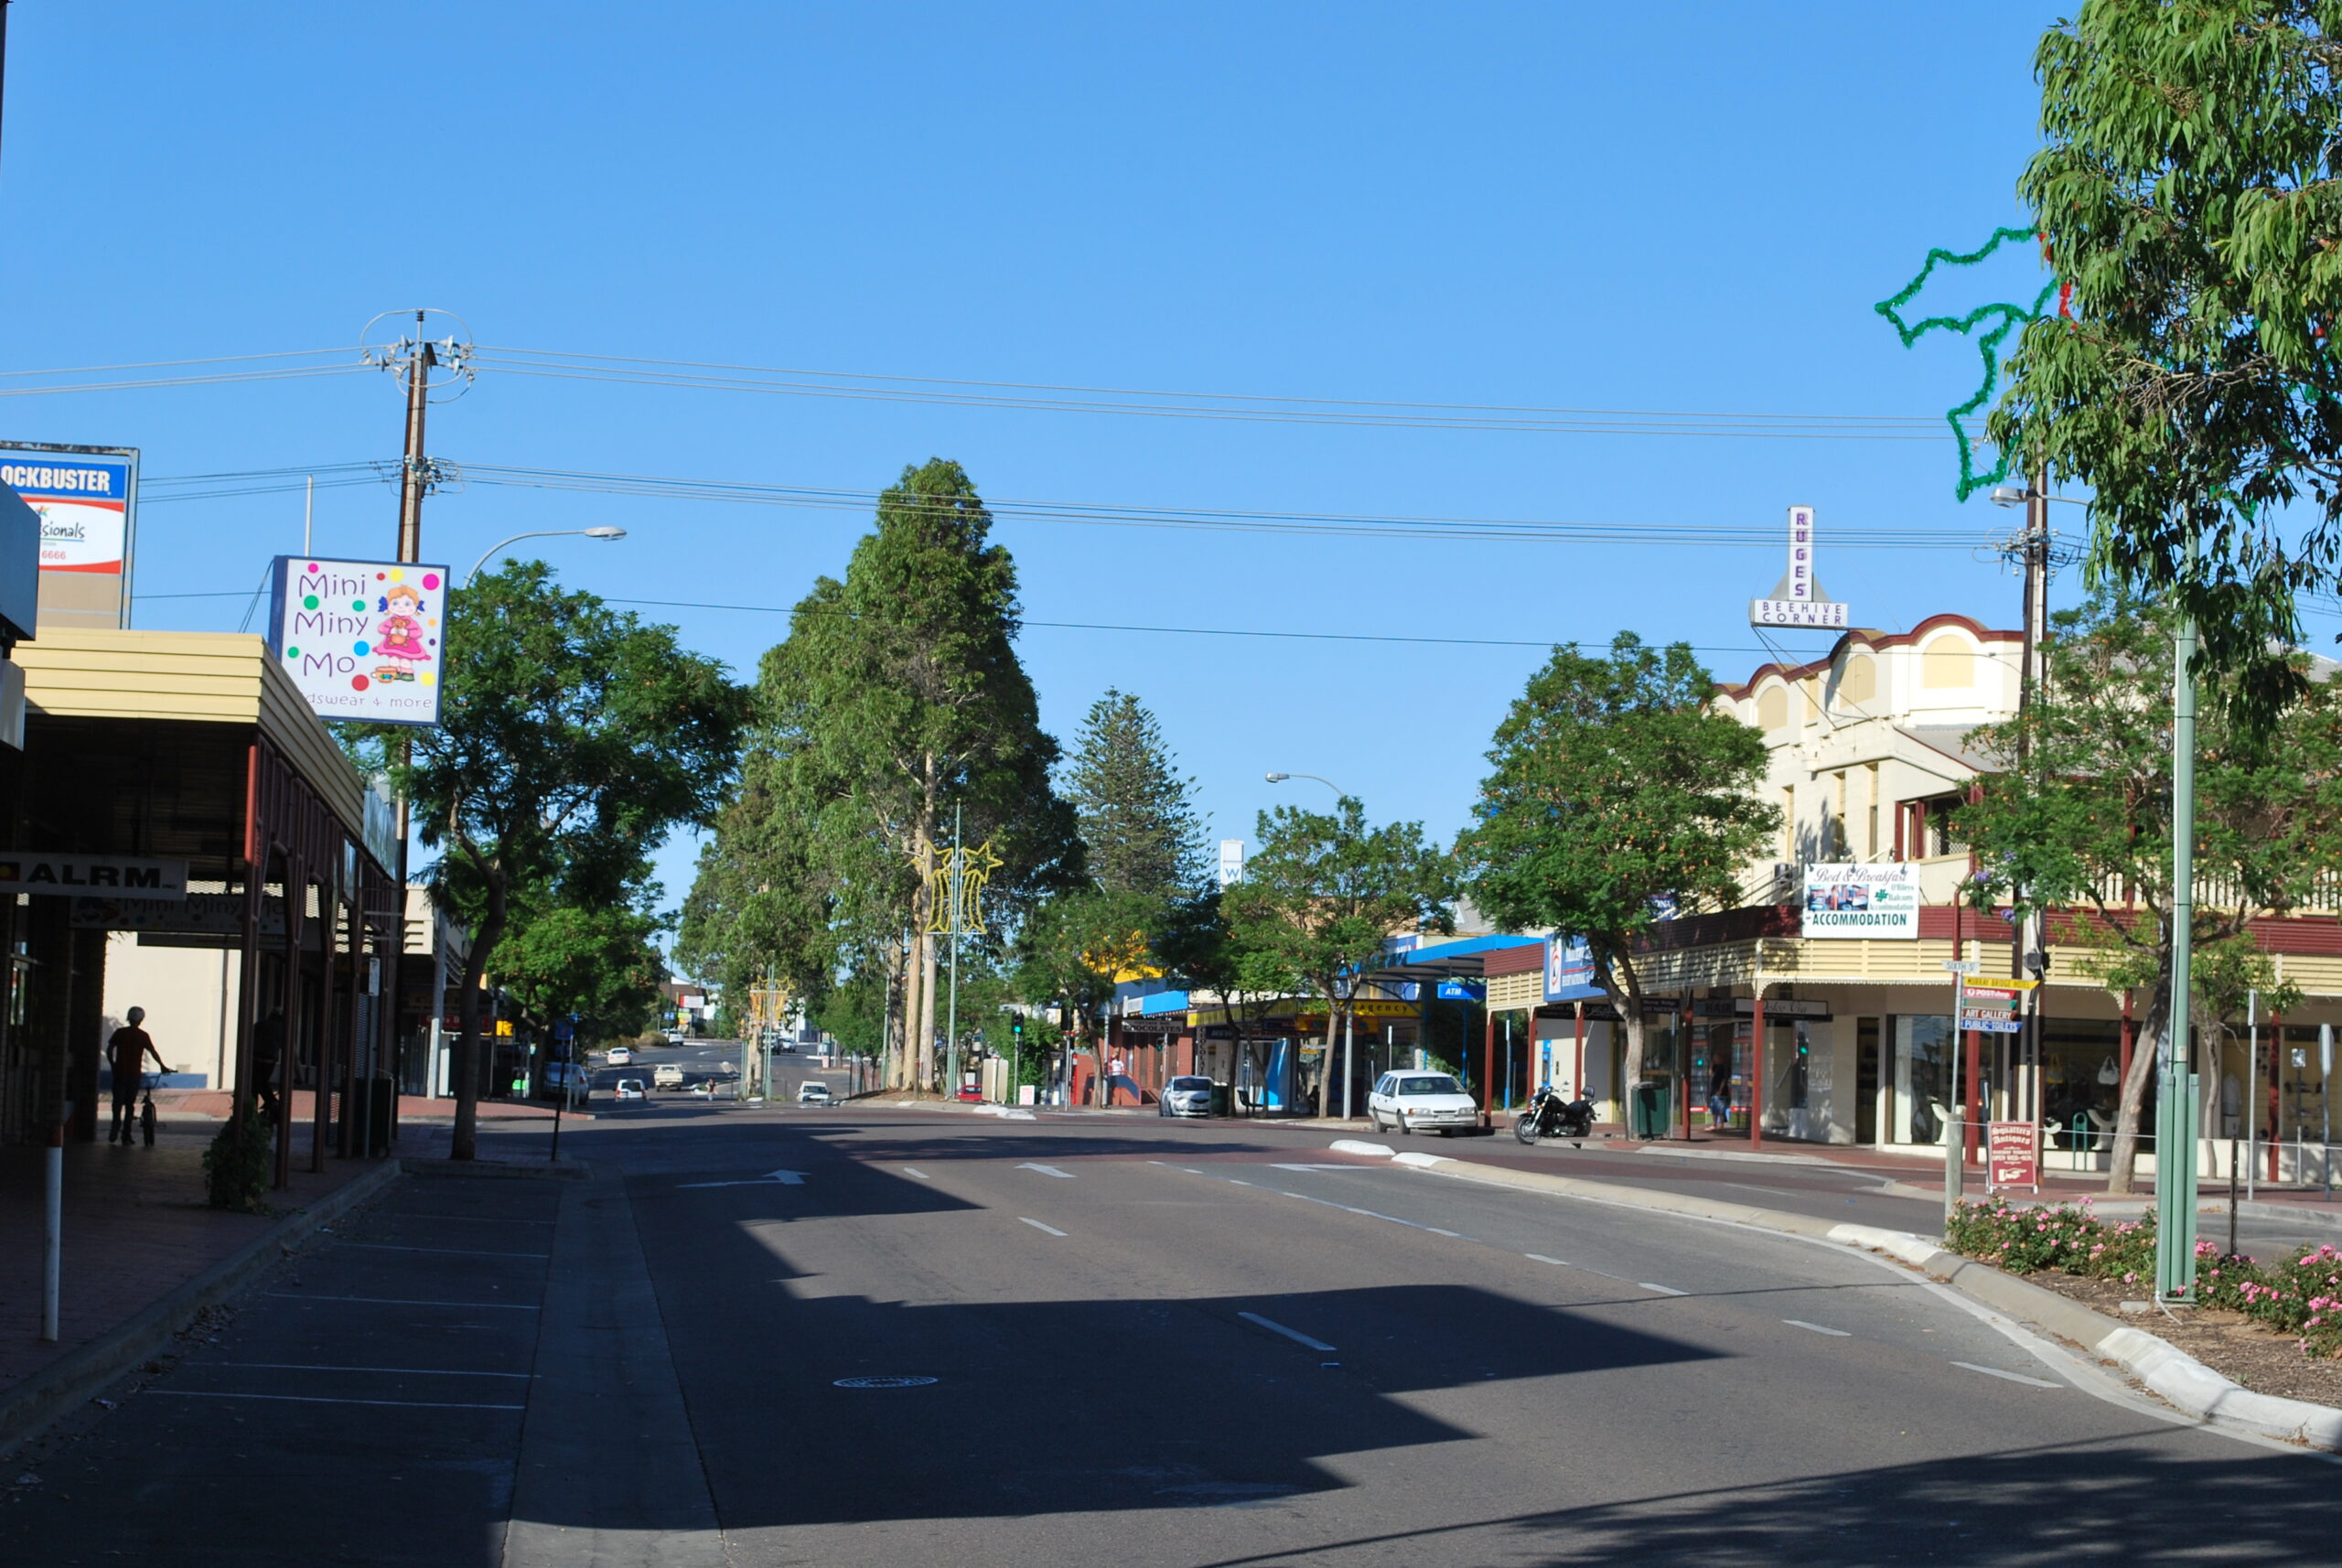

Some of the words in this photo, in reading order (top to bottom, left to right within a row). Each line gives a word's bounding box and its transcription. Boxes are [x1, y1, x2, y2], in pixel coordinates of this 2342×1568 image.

[42, 551, 66, 560] 6666
[1795, 512, 1809, 596] RUGES
[299, 574, 366, 599] Mini
[1763, 602, 1842, 615] BEEHIVE
[295, 611, 369, 637] Miny
[1762, 612, 1842, 625] CORNER
[304, 652, 355, 678] Mo
[390, 697, 432, 708] more
[27, 863, 161, 888] ALRM
[1814, 867, 1841, 883] Bed
[1853, 867, 1908, 886] Breakfast
[1812, 913, 1907, 926] ACCOMMODATION
[1947, 961, 1966, 971] SIXTH
[1445, 987, 1462, 995] ATM
[1360, 1004, 1408, 1013] Agency
[1966, 1008, 1979, 1018] ART
[1982, 1009, 2012, 1020] GALLERY
[1964, 1018, 1988, 1028] PUBLIC
[1991, 1020, 2018, 1032] TOILETS
